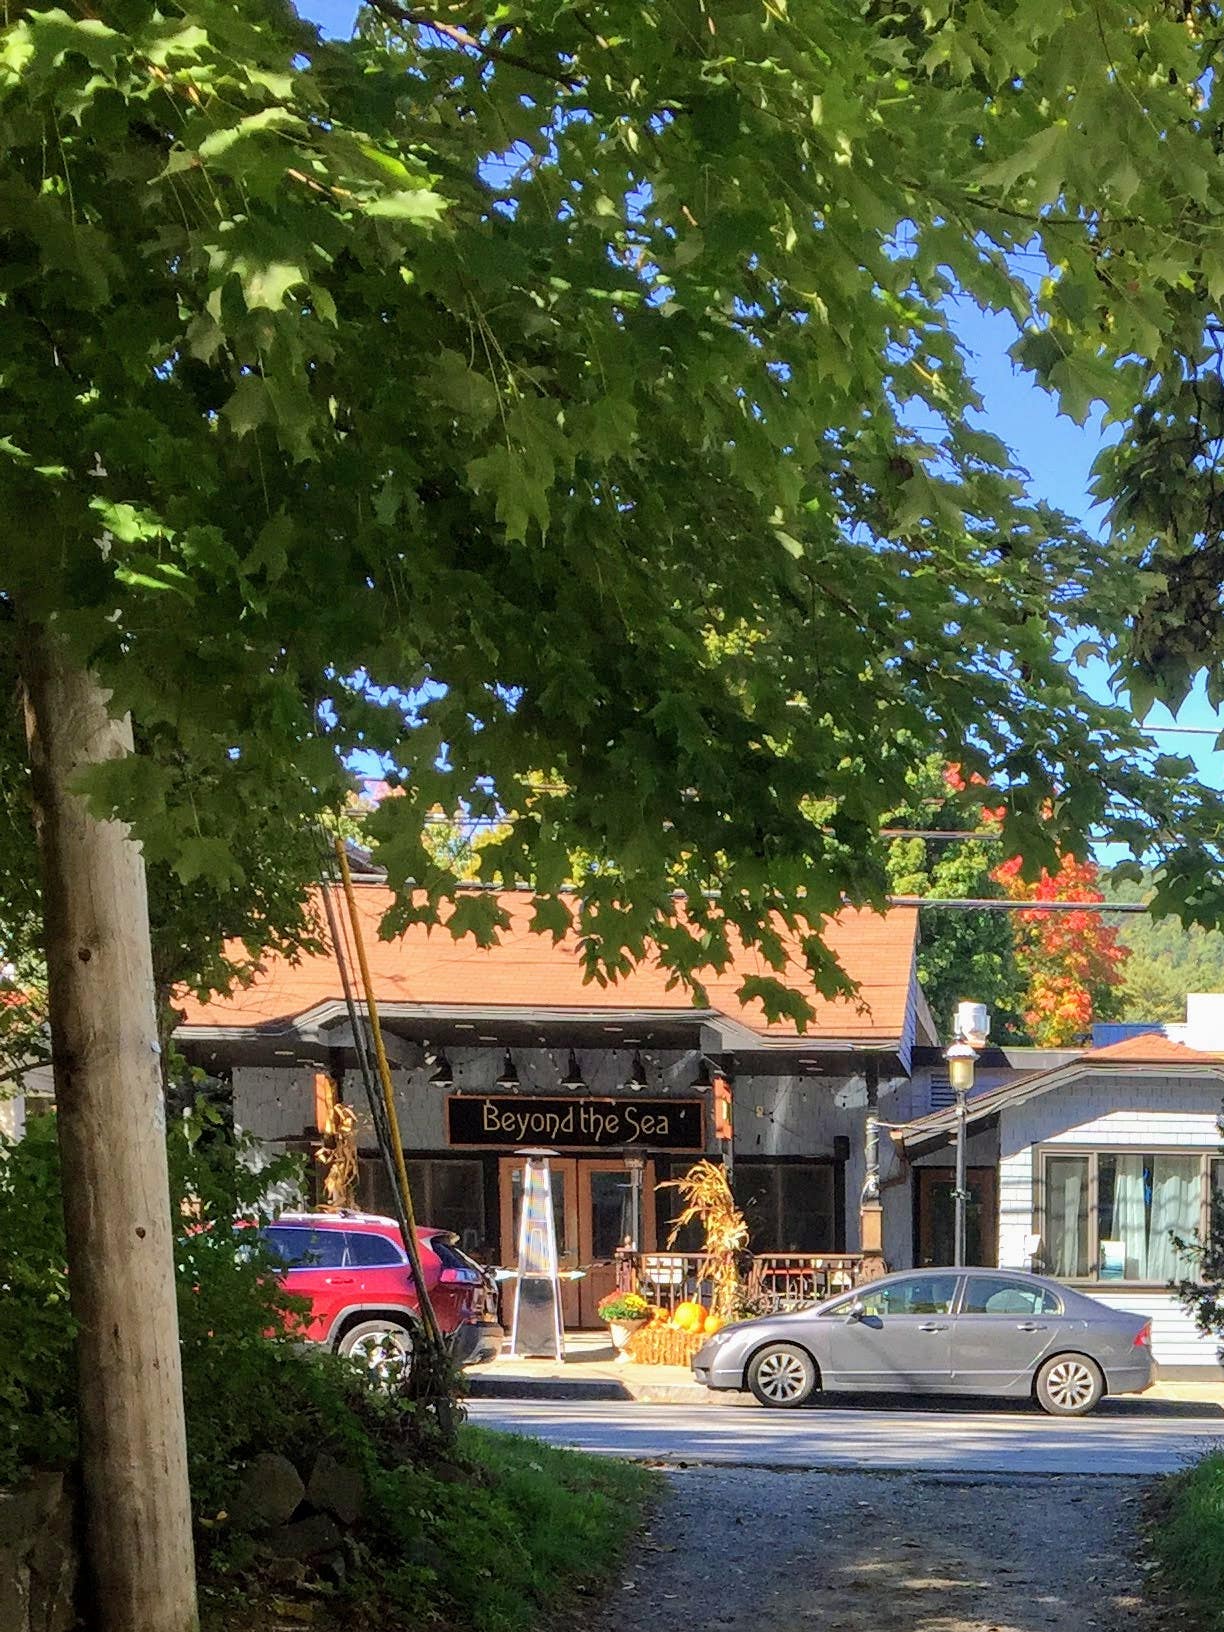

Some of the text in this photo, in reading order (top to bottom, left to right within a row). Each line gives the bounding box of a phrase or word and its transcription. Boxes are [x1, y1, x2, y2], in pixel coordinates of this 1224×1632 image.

[483, 1102, 669, 1143] Beyond the Sea
